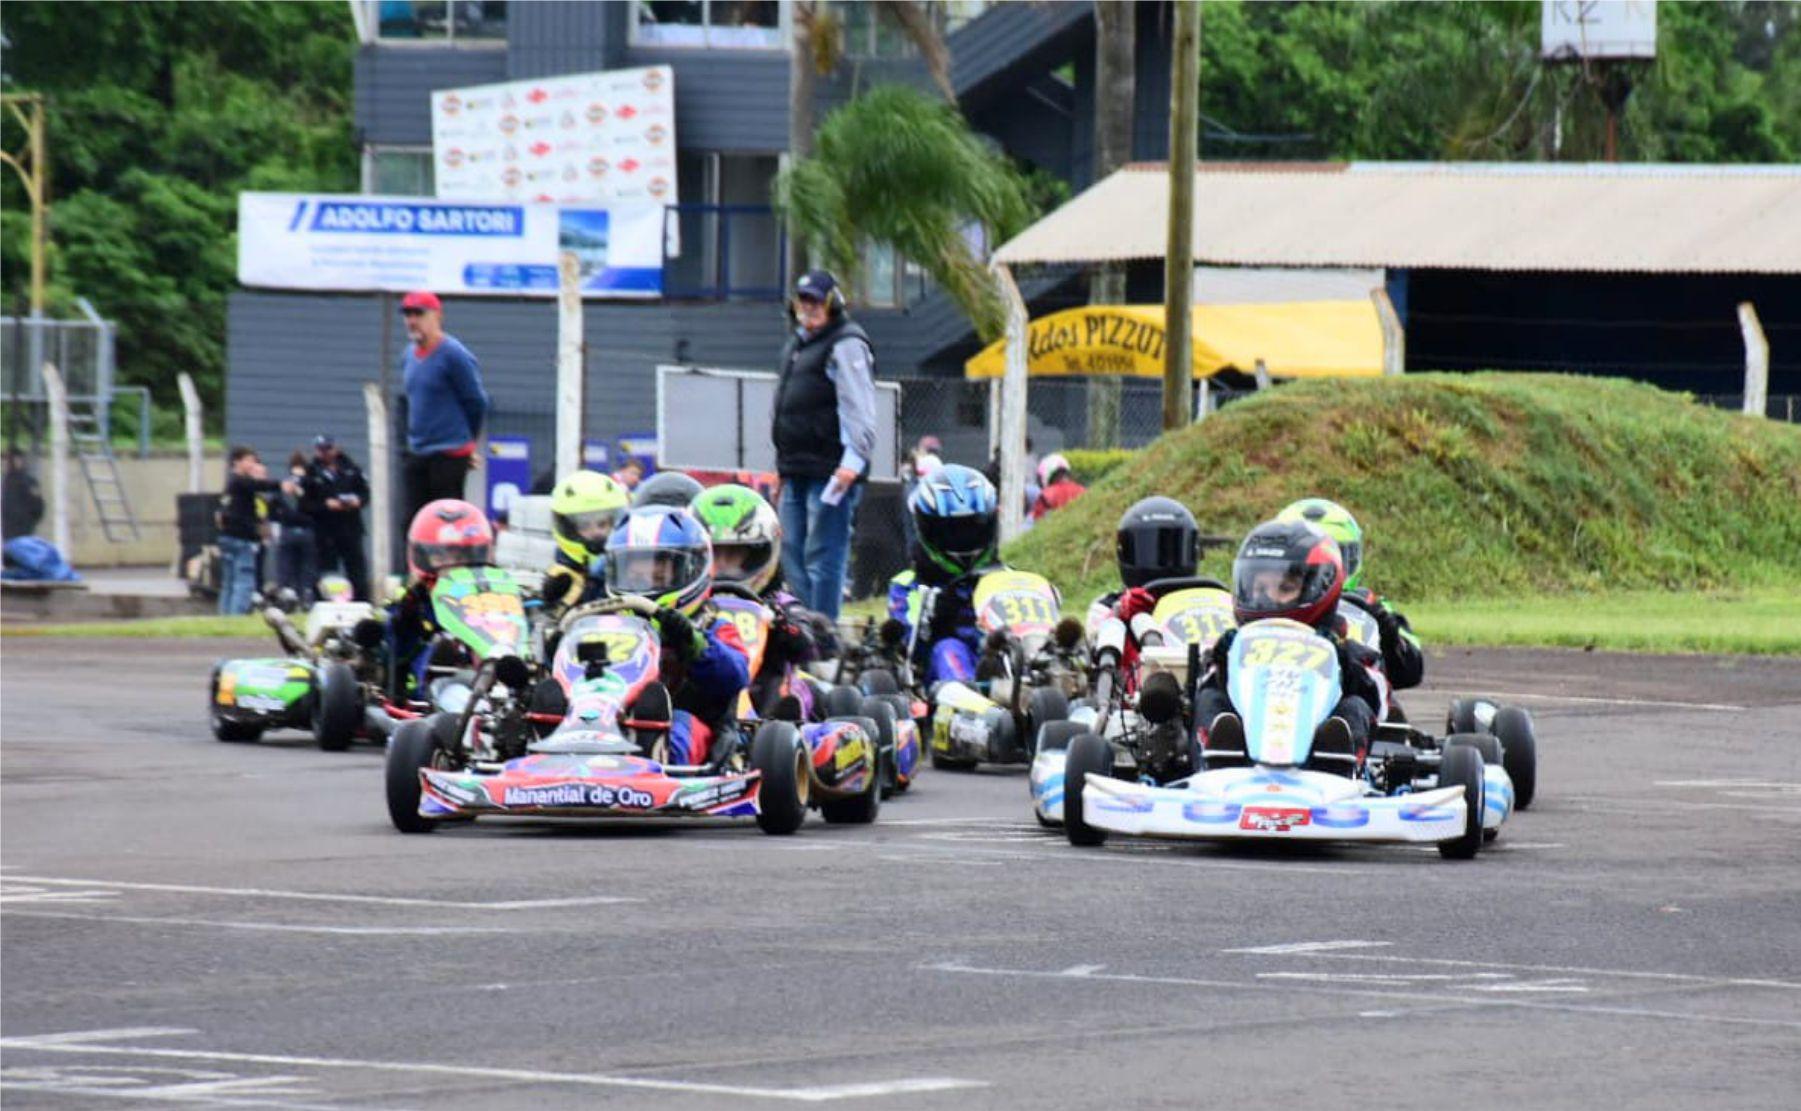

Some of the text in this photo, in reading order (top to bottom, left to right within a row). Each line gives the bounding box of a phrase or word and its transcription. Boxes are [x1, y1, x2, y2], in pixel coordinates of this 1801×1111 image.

[321, 207, 515, 231] ADOLFO SARTORI
[1084, 315, 1165, 360] PIZZUT
[1003, 597, 1056, 627] 311
[1244, 639, 1331, 670] 327
[505, 786, 652, 806] Manantial de Oro
